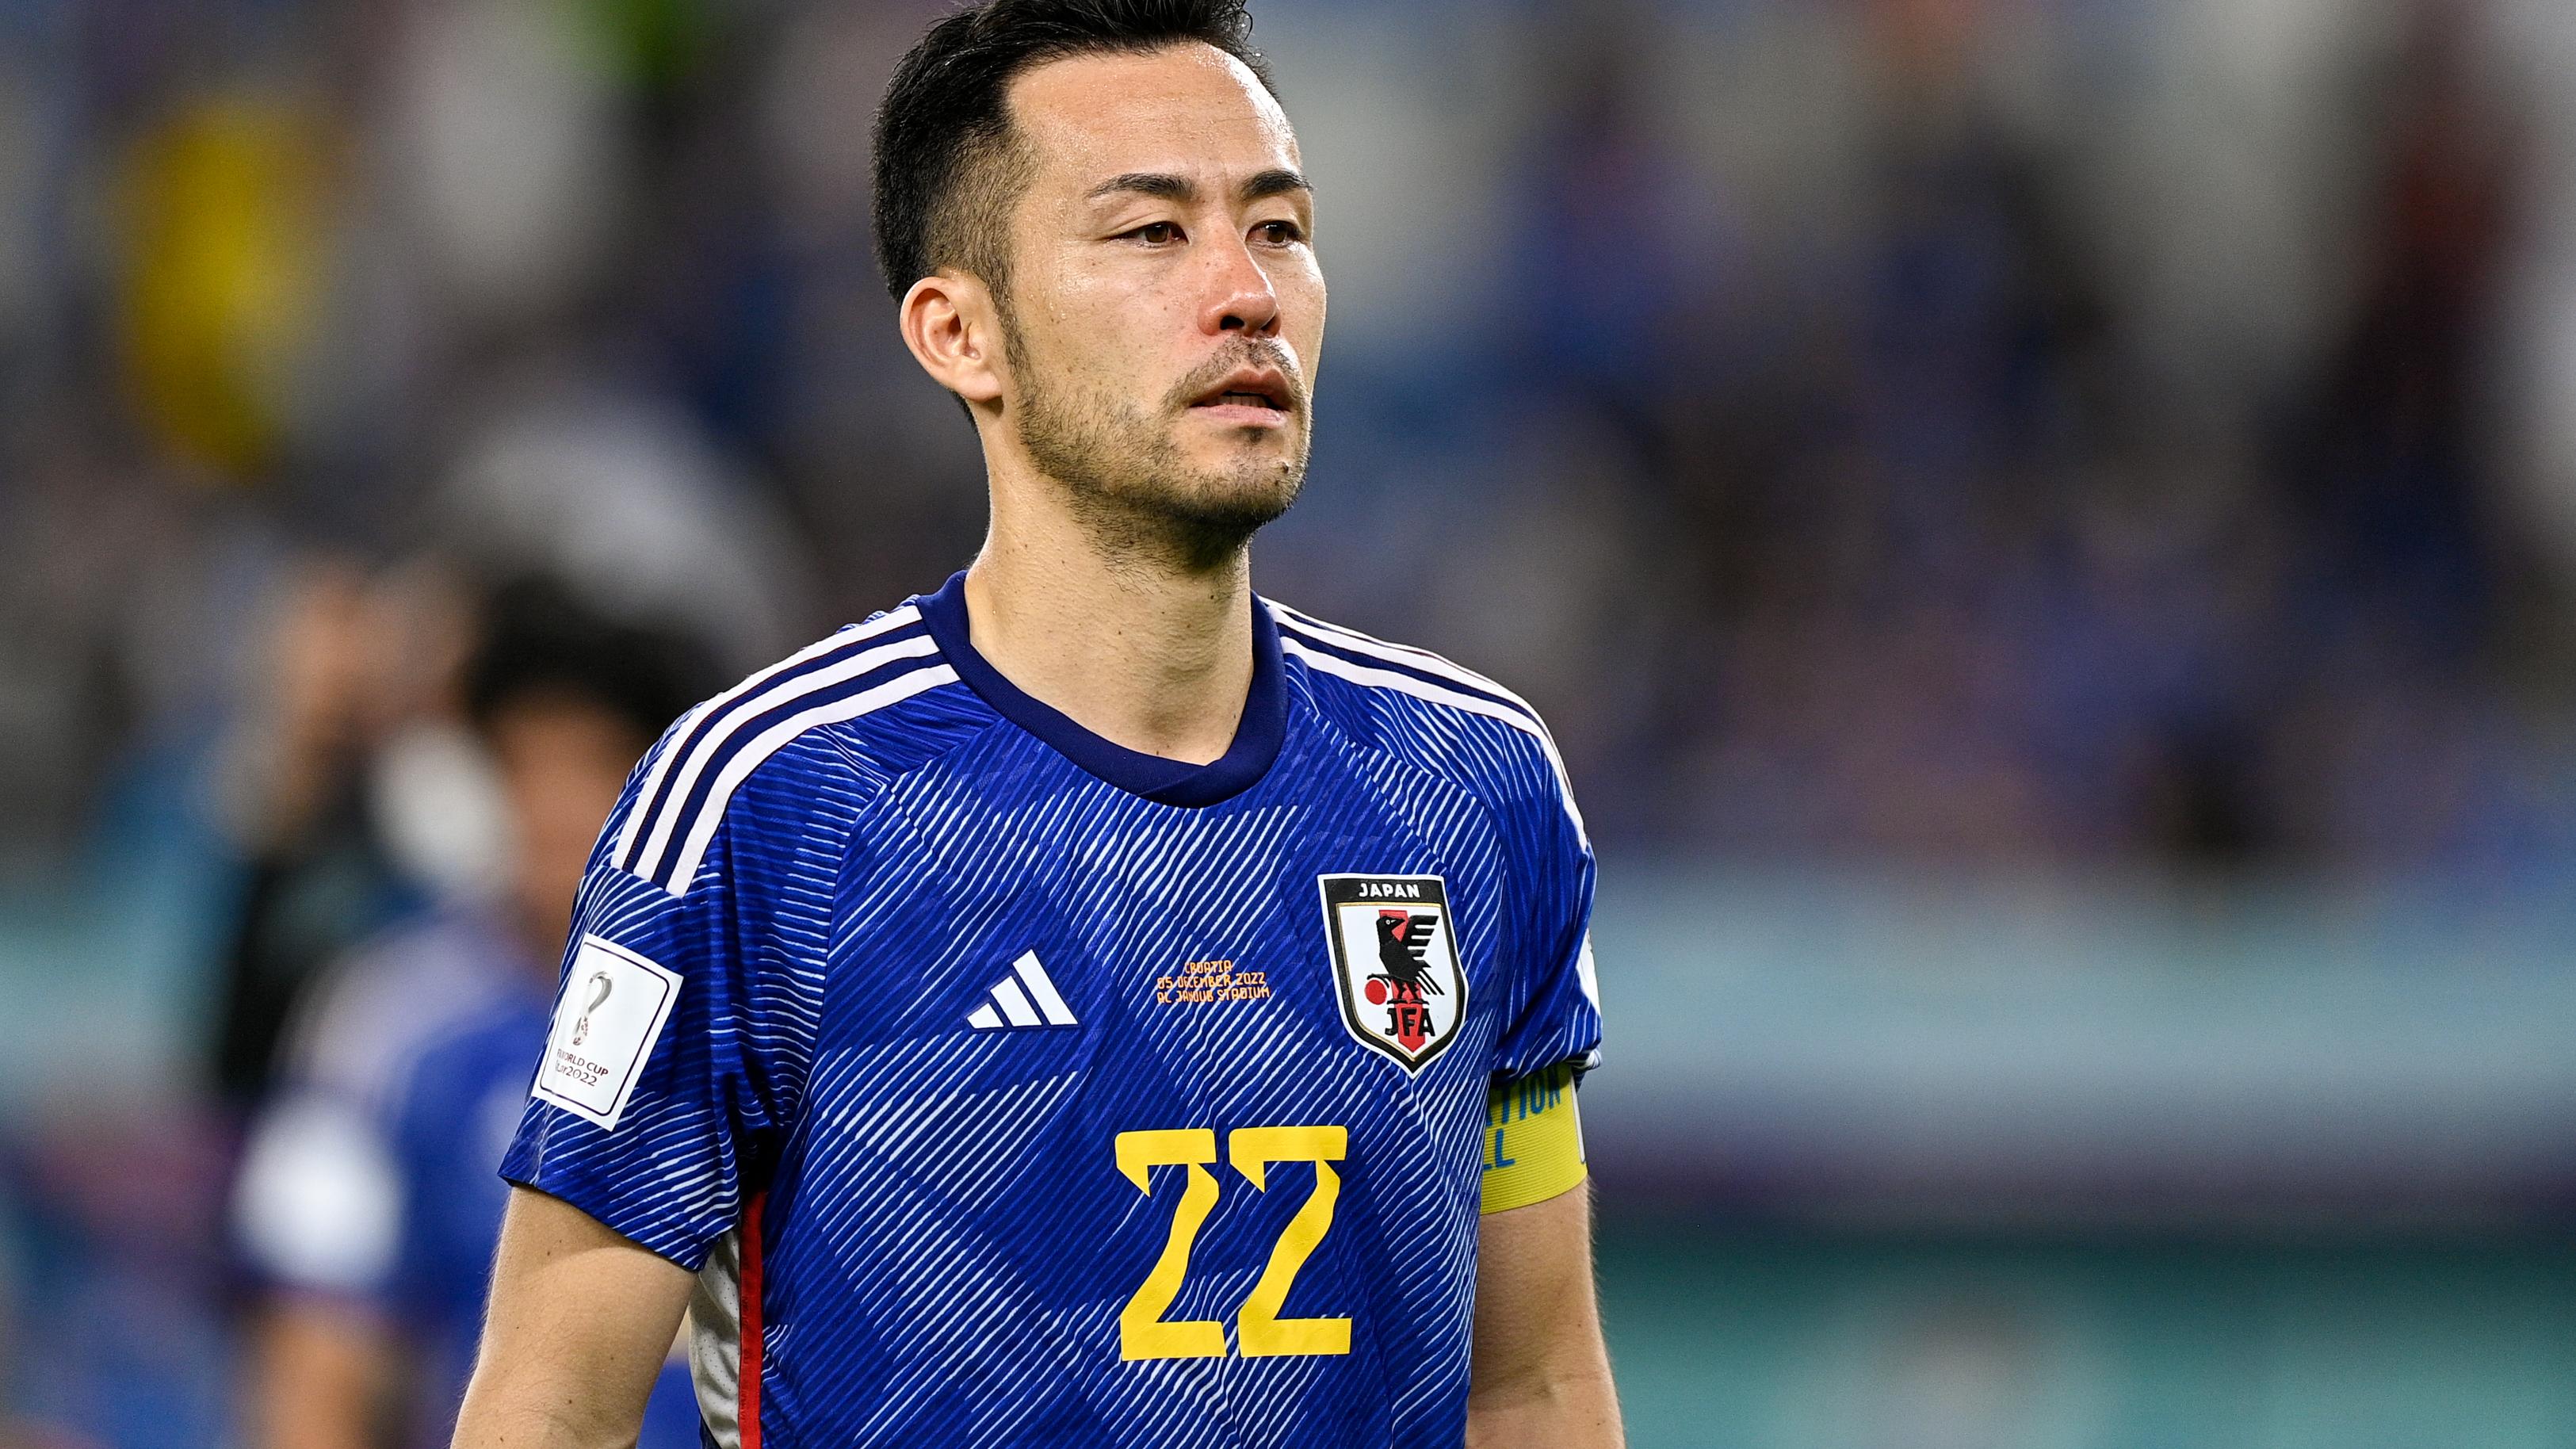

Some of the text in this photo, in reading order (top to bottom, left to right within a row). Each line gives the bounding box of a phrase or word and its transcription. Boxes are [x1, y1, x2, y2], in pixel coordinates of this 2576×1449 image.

[1359, 882, 1420, 898] JAPAN
[1185, 960, 1232, 974] CROATIA
[1157, 972, 1266, 989] 05 DECEMBER 2022
[1157, 987, 1270, 1003] AL JANOUB STADIUM
[1385, 1008, 1435, 1037] JFA
[587, 1062, 609, 1076] CUP
[1114, 1126, 1352, 1361] 22
